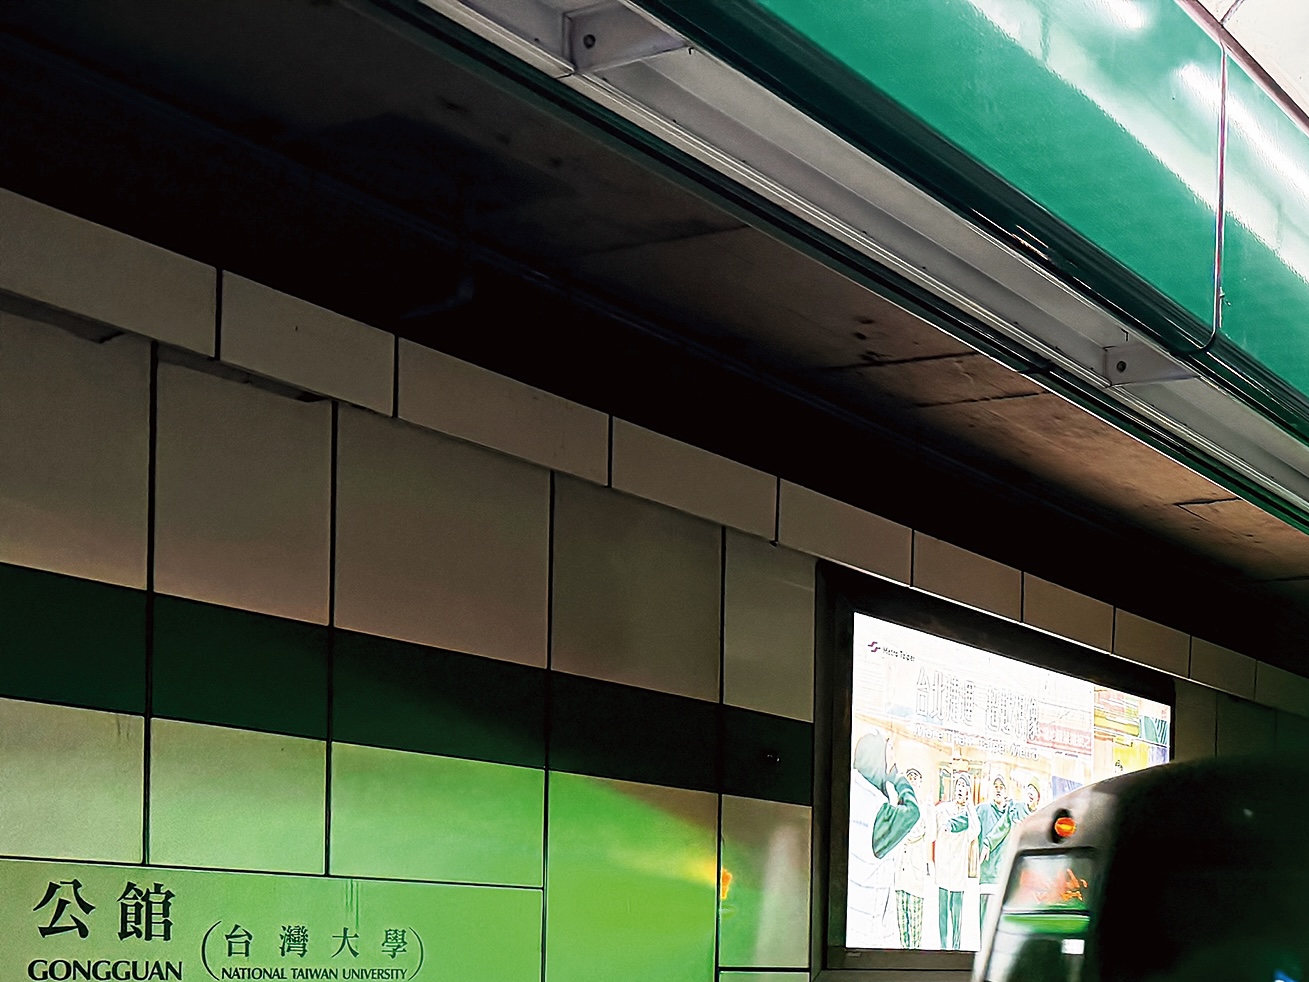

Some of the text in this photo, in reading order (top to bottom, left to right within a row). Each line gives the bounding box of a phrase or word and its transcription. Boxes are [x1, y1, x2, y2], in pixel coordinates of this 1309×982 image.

[33, 878, 176, 942] 公館
[223, 924, 409, 959] 台灣大學
[27, 958, 183, 982] GONGGUAN
[221, 967, 409, 981] NATIONAL TAIWAN UNIVERSITY
